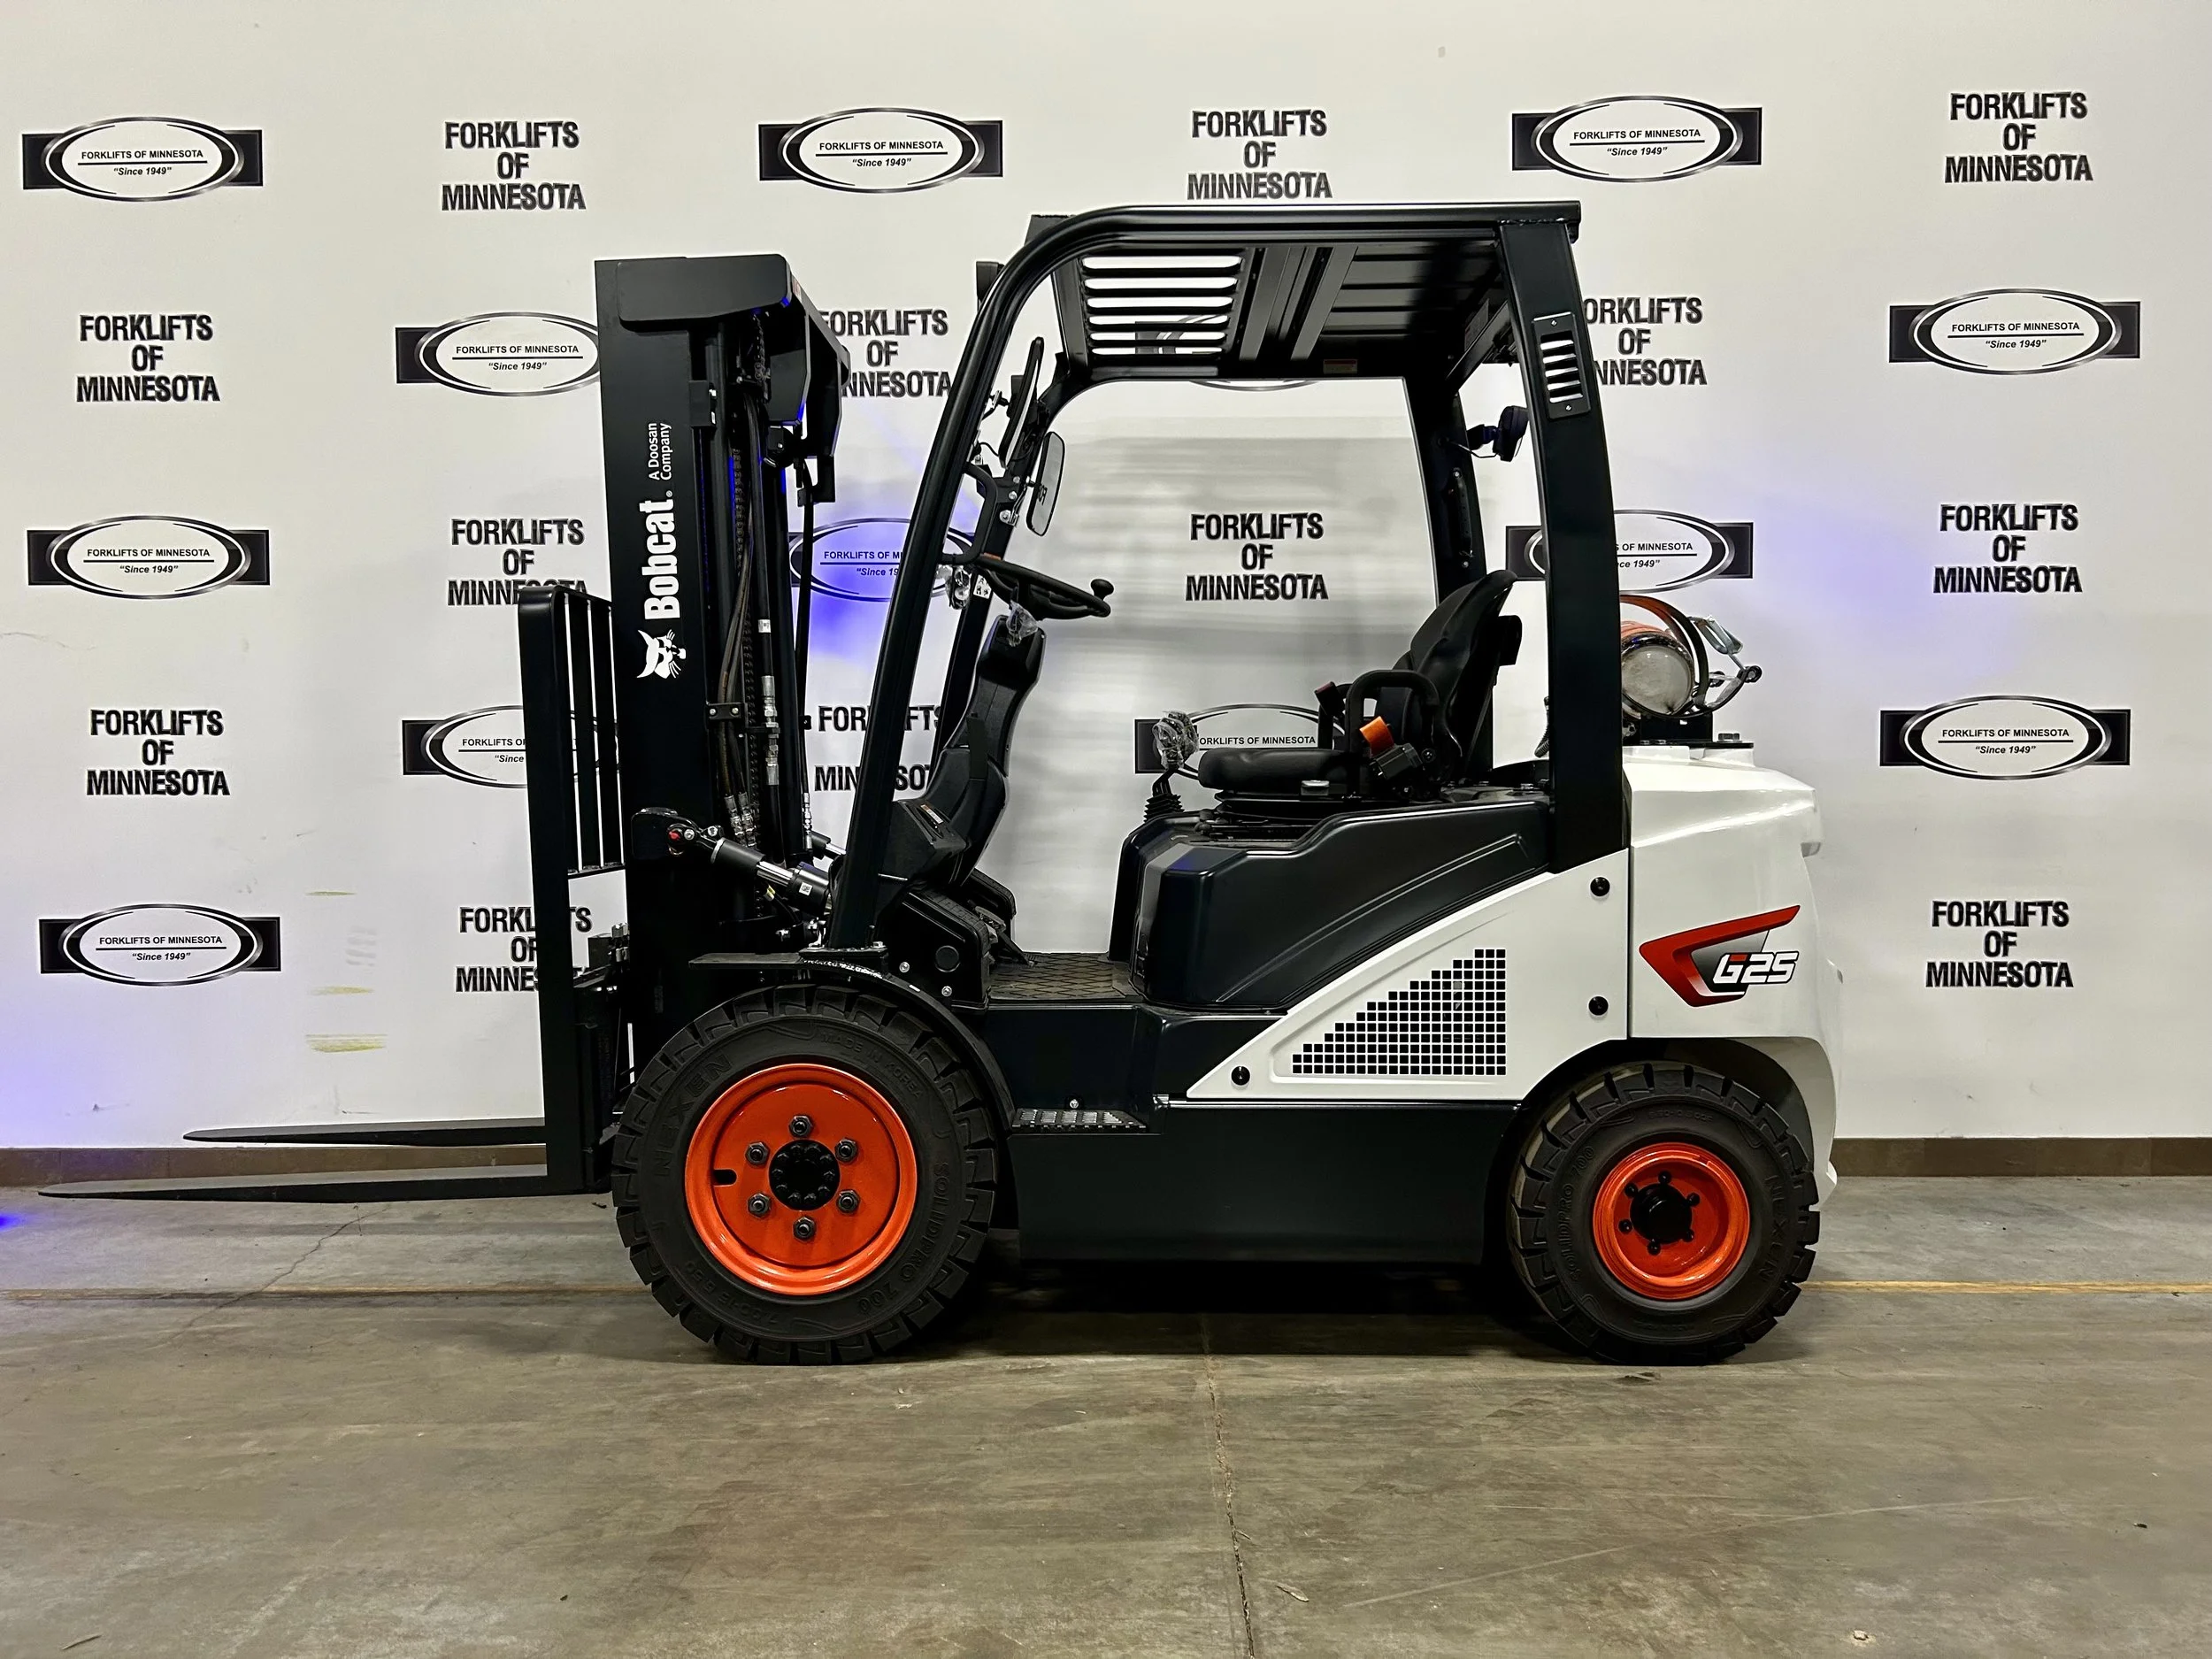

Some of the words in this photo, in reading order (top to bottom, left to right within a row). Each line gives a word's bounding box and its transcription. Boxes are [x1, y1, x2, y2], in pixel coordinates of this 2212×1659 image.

[1951, 92, 2087, 120] FORKLIFTS
[445, 121, 579, 149] FORKLIFTS
[1193, 110, 1326, 137] FORKLIFTS
[1573, 131, 1627, 140] FORKLIFTS
[1628, 130, 1643, 139] OF
[1644, 128, 1701, 139] MINNESOTA
[2003, 123, 2036, 150] OF
[81, 150, 133, 160] FORKLIFTS
[134, 150, 147, 158] OF
[149, 150, 204, 158] MINNESOTA
[819, 142, 872, 151] FORKLIFTS
[873, 142, 887, 150] OF
[888, 141, 944, 150] MINNESOTA
[1244, 141, 1276, 168] OF
[497, 152, 529, 179] OF
[1945, 154, 2093, 183] MINNESOTA
[442, 183, 586, 211] MINNESOTA
[1187, 172, 1333, 200] MINNESOTA
[1583, 297, 1702, 324] ORKLIFTS
[81, 314, 213, 341] FORKLIFTS
[1951, 323, 2006, 333] FORKLIFTS
[2008, 322, 2022, 332] OF
[2024, 321, 2080, 331] MINNESOTA
[456, 345, 507, 354] FORKLIFTS
[509, 345, 522, 354] OF
[524, 345, 580, 354] MINNESOTA
[867, 340, 898, 366] OF
[1618, 328, 1651, 355] OF
[132, 345, 163, 372] OF
[1594, 358, 1708, 386] NNESOTA
[77, 375, 220, 402] MINNESOTA
[842, 371, 951, 397] NNESOTA
[648, 422, 659, 467] Doosan
[659, 422, 672, 480] Company
[648, 471, 660, 480] A
[1191, 512, 1324, 540] FORKLIFTS
[1940, 503, 2078, 531] FORKLIFTS
[452, 518, 584, 545] FORKLIFTS
[87, 549, 139, 557] FORKLIFTS
[140, 549, 154, 557] OF
[155, 549, 211, 557] MINNESOTA
[639, 500, 680, 619] Bobcat
[824, 550, 875, 560] FORKLIFTS
[877, 550, 890, 560] OF
[1241, 543, 1273, 570] OF
[1622, 542, 1635, 551] OF
[1637, 542, 1694, 551] MINNESOTA
[1993, 534, 2026, 562] OF
[503, 549, 534, 575] OF
[1186, 573, 1328, 601] MINNESOTA
[1933, 565, 2082, 593] MINNESOTA
[448, 580, 587, 606] MINNE
[91, 710, 224, 736] FORKLIFTS
[1942, 728, 1995, 738] FORKLIFTS
[1997, 728, 2011, 737] OF
[2013, 728, 2070, 737] MINNESOTA
[142, 739, 173, 765] OF
[462, 738, 513, 747] FORKLIFTS
[1199, 736, 1245, 745] ORKLIFTS
[1247, 736, 1260, 745] OF
[1262, 735, 1317, 745] MINNESOTA
[87, 769, 230, 795] MINNESOTA
[459, 907, 591, 933] FORKLS
[1932, 901, 2070, 927] FORKLIFTS
[99, 936, 151, 945] FORKLIFTS
[152, 936, 166, 945] OF
[167, 935, 223, 944] MINNESOTA
[1984, 931, 2017, 957] OF
[1712, 951, 1800, 984] G25
[1926, 961, 2073, 987] MINNESOTA
[652, 1050, 733, 1178] NEXEN
